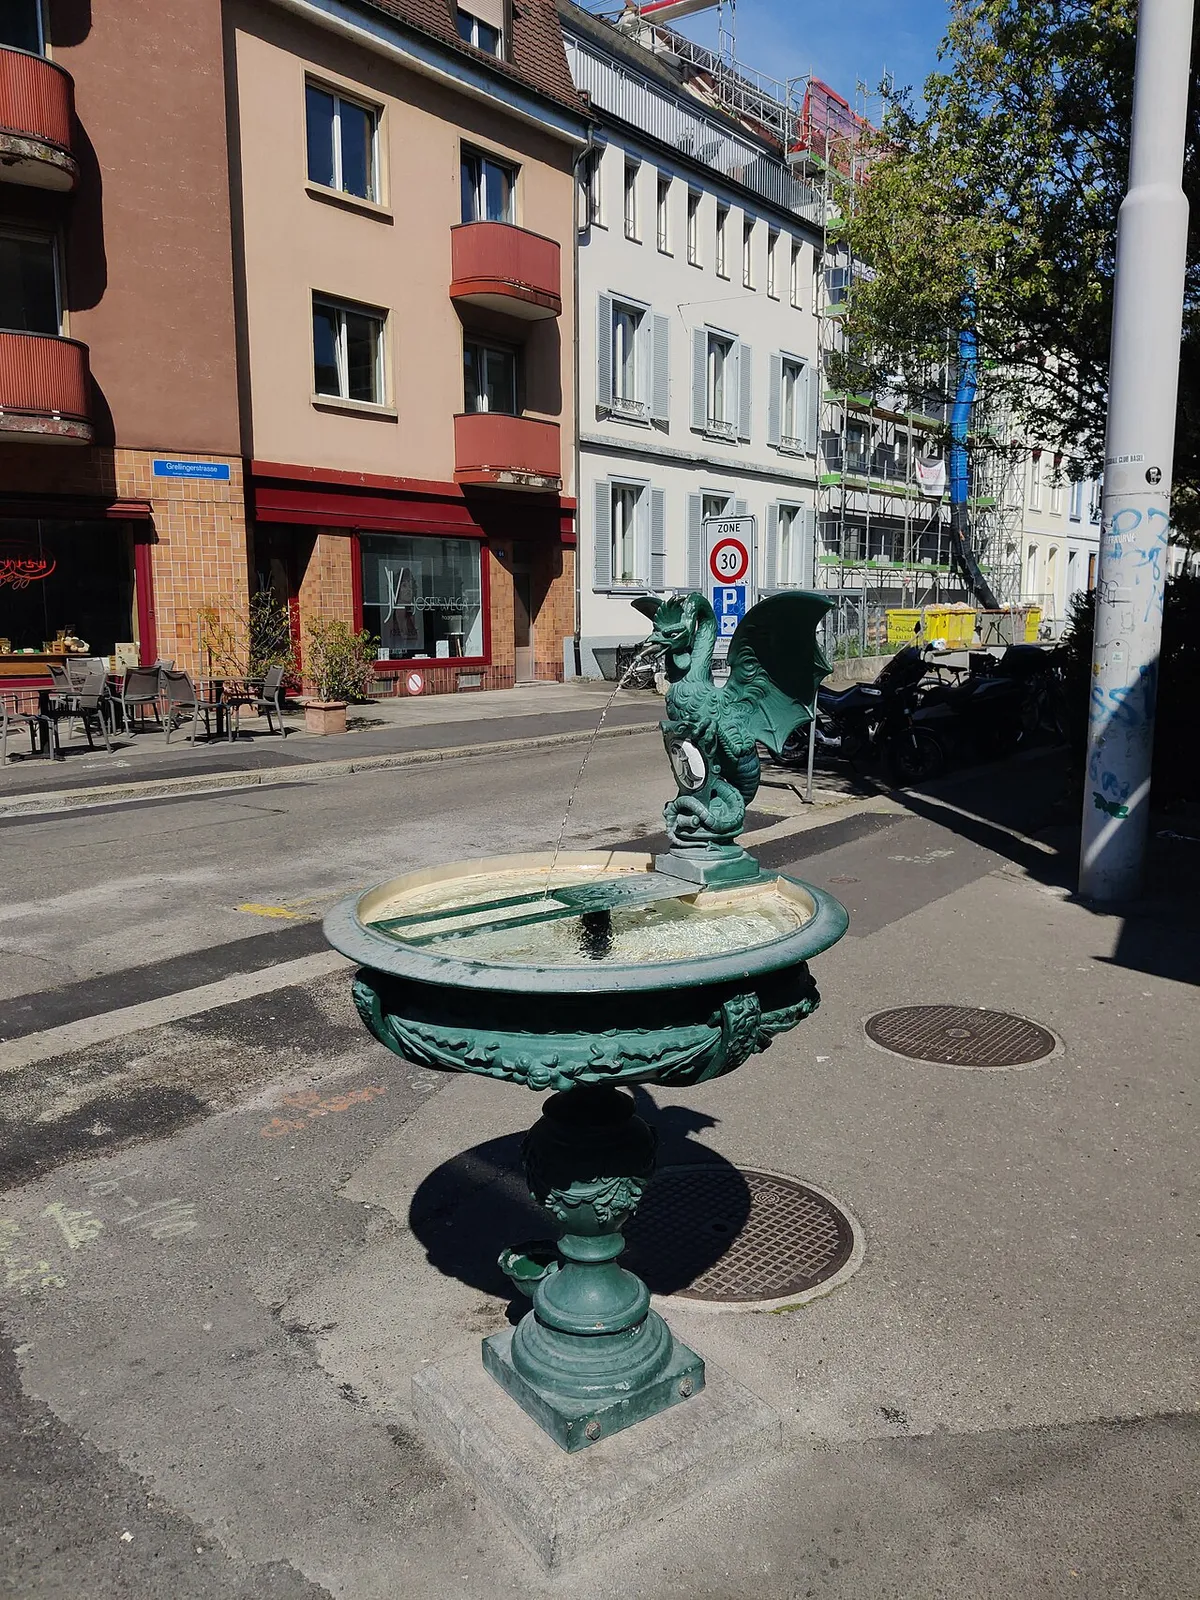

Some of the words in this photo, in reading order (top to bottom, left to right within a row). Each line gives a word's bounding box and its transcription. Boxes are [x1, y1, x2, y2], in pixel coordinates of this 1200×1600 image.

[165, 462, 218, 473] Grellingerstrasse
[717, 523, 741, 533] ZONE
[720, 553, 737, 570] 30
[722, 588, 738, 614] P
